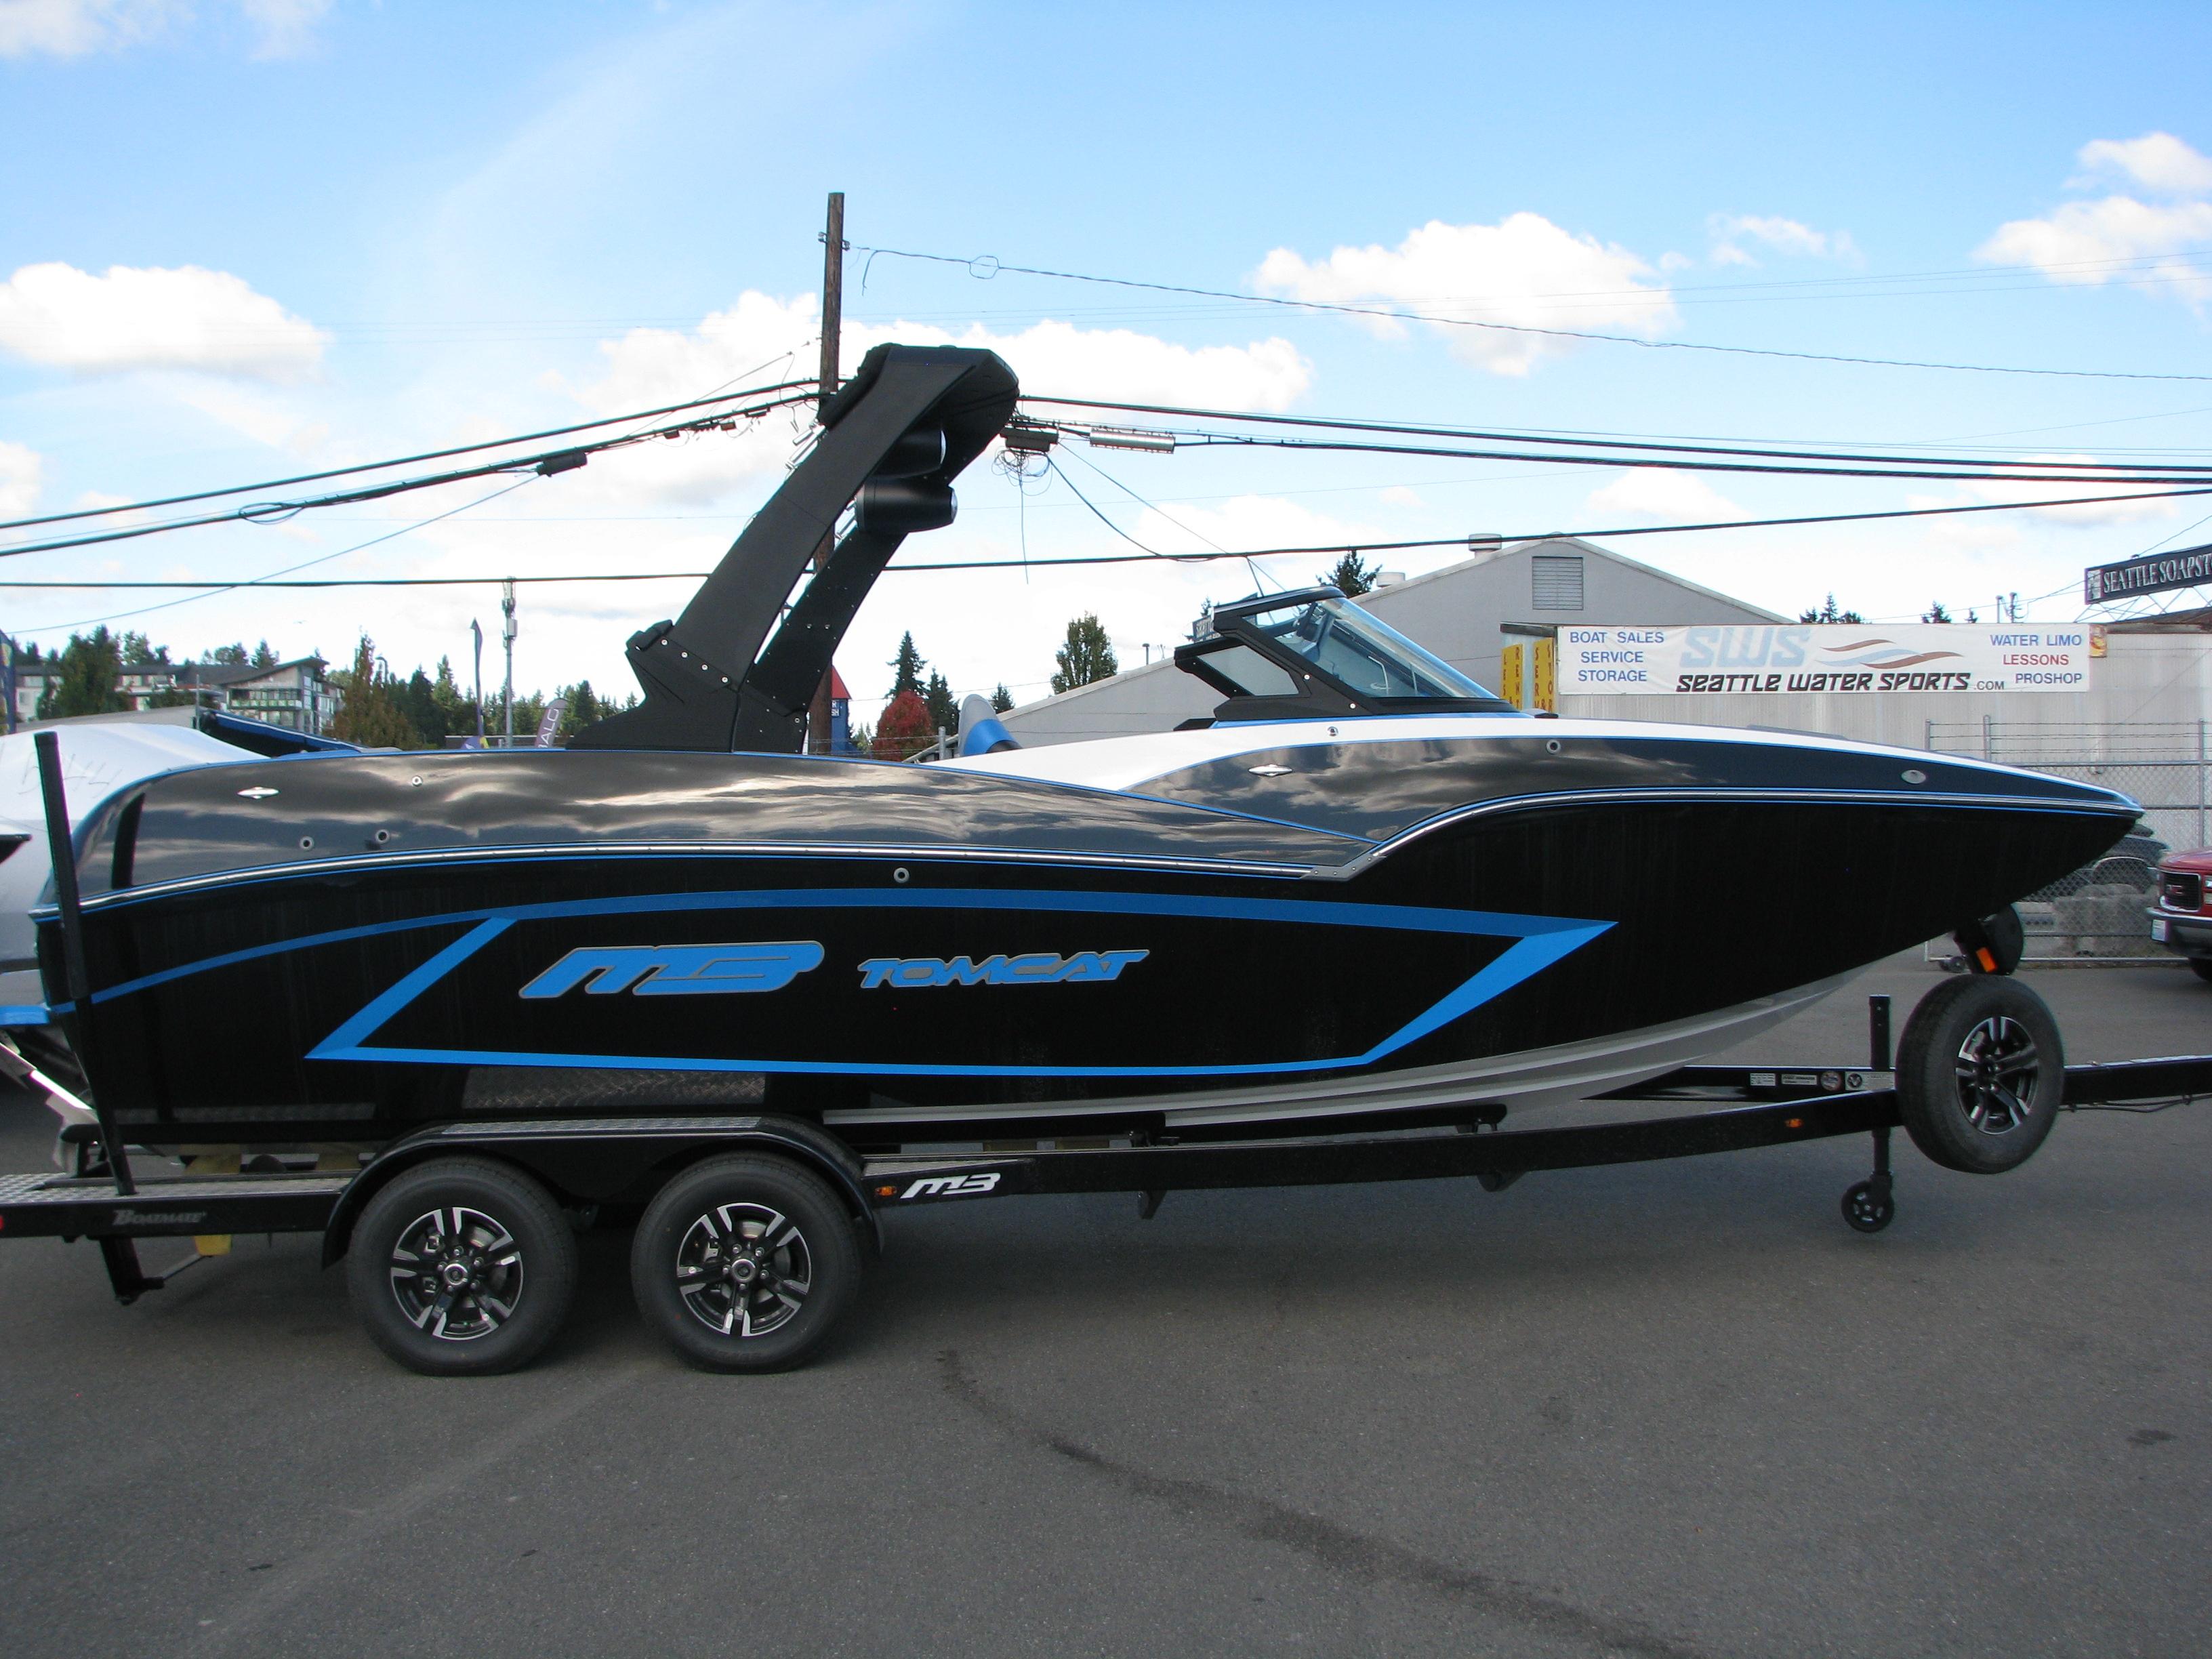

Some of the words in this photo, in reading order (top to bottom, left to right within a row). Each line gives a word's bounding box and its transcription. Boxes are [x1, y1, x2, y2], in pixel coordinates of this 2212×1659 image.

[2104, 563, 2158, 594] SEATTLE
[2159, 553, 2212, 582] SOAPST
[1570, 632, 1607, 643] BOAT
[1617, 631, 1664, 643] SALES
[1990, 634, 2039, 647] WATER
[2046, 634, 2082, 646] LIMO
[1679, 626, 1811, 668] SWS
[1580, 651, 1643, 663] SERVICE
[2003, 654, 2069, 665] LESSONS
[1578, 670, 1647, 682] STORAGE
[1877, 672, 1971, 691] SPORTS
[1974, 680, 2005, 691] .COM
[2015, 672, 2083, 684] PROSHOP
[857, 949, 1150, 989] TOMCAT
